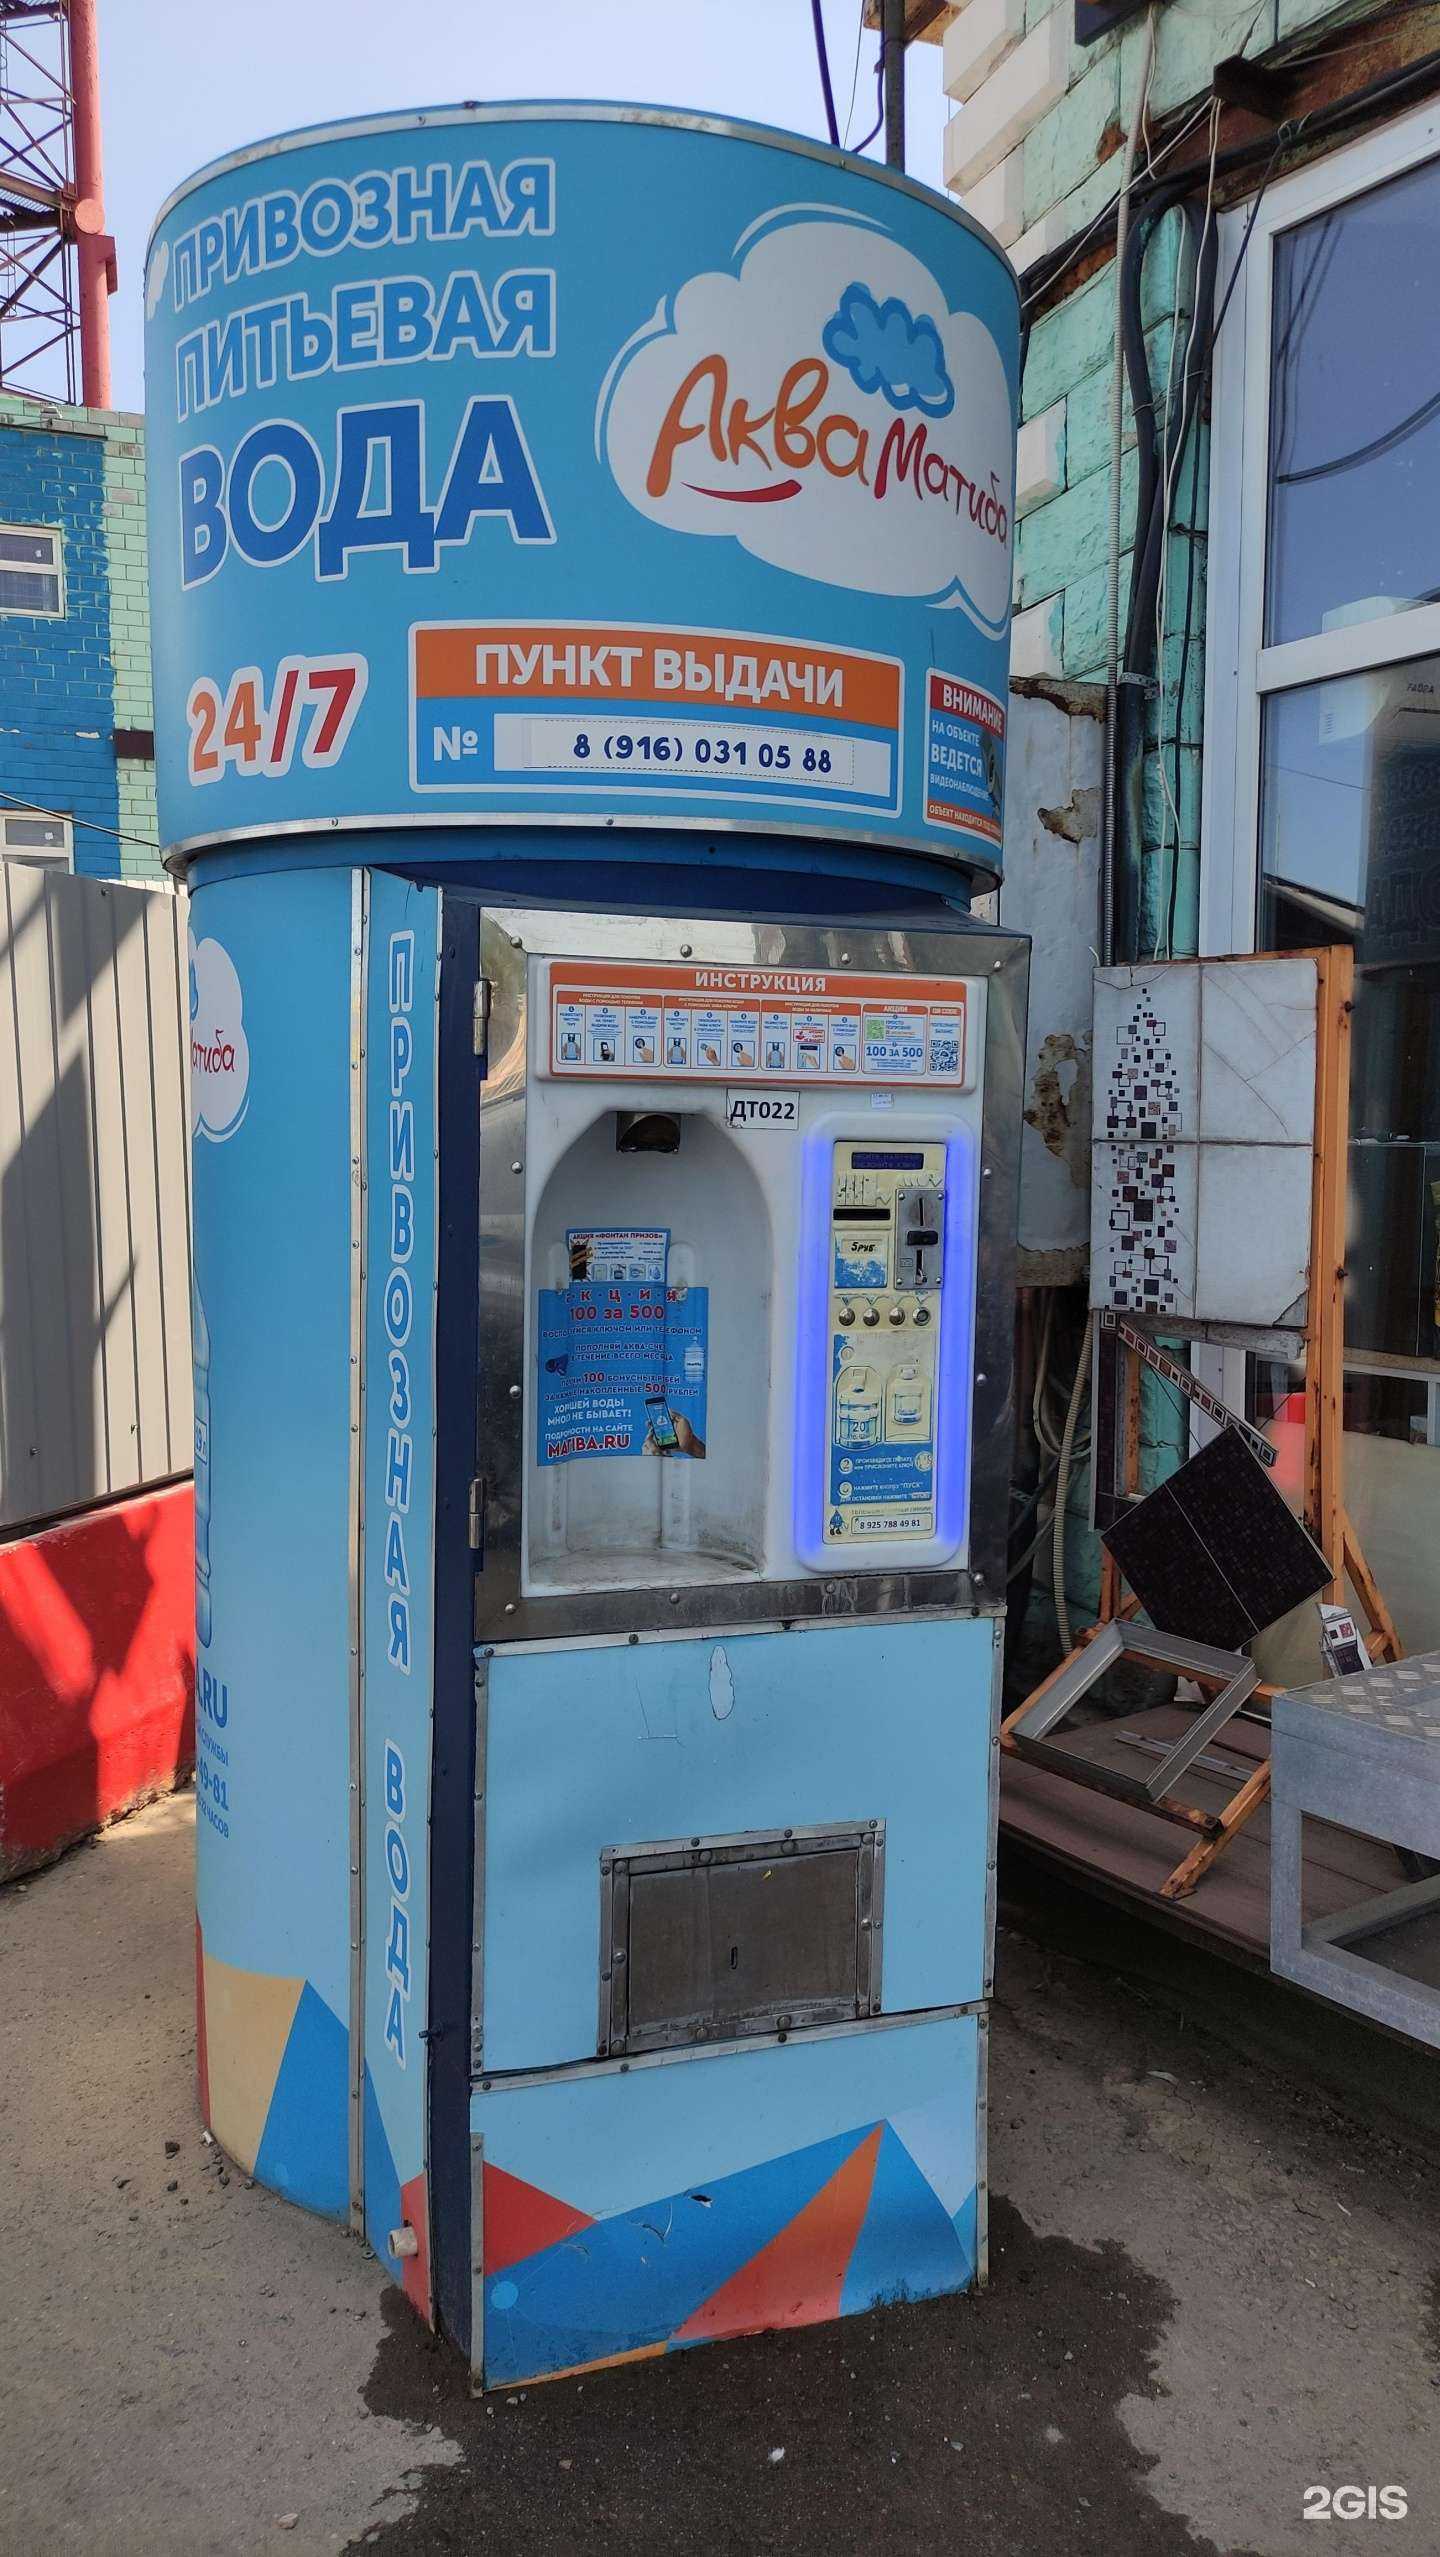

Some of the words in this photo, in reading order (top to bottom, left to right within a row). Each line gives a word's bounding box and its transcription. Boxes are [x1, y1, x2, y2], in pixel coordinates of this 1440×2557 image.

[173, 158, 556, 312] ПРИВОЗНАЯ
[175, 269, 556, 421] ПИТЬЕВАЯ
[179, 395, 556, 591] ВОДА
[475, 643, 643, 692] ПУНКТ
[655, 652, 844, 708] ВЫДАЧИ
[187, 653, 368, 785] 24/7
[943, 684, 1002, 733] ВНИМАНИЕ
[432, 724, 479, 761] №
[932, 720, 945, 736] НА
[946, 724, 981, 748] ОБЪЕКТЕ
[573, 734, 591, 760] 8
[603, 733, 684, 765] (916)
[694, 738, 747, 766] 031
[757, 743, 792, 771] 05
[802, 747, 833, 775] 88
[931, 743, 983, 779] ВЕДЕТСЯ
[695, 970, 827, 993] ИНСТРУКЦИЯ
[866, 1046, 887, 1057] 100
[889, 1048, 900, 1058] ЗА
[902, 1047, 923, 1058] 500
[729, 1099, 795, 1121] ДТ022
[569, 1306, 597, 1321] 100
[629, 1305, 665, 1320] 500
[583, 1372, 606, 1384] 100
[572, 1411, 584, 1420] НЕ
[586, 1408, 632, 1420] БЫВАЕТ!
[592, 1398, 625, 1408] ВОДЫ
[592, 1424, 604, 1432] НА
[605, 1422, 634, 1432] САЙТЕ
[852, 1421, 866, 1433] 20
[860, 1521, 865, 1530] 8
[866, 1521, 882, 1529] 925
[883, 1520, 898, 1528] 788
[911, 1519, 921, 1527] 81
